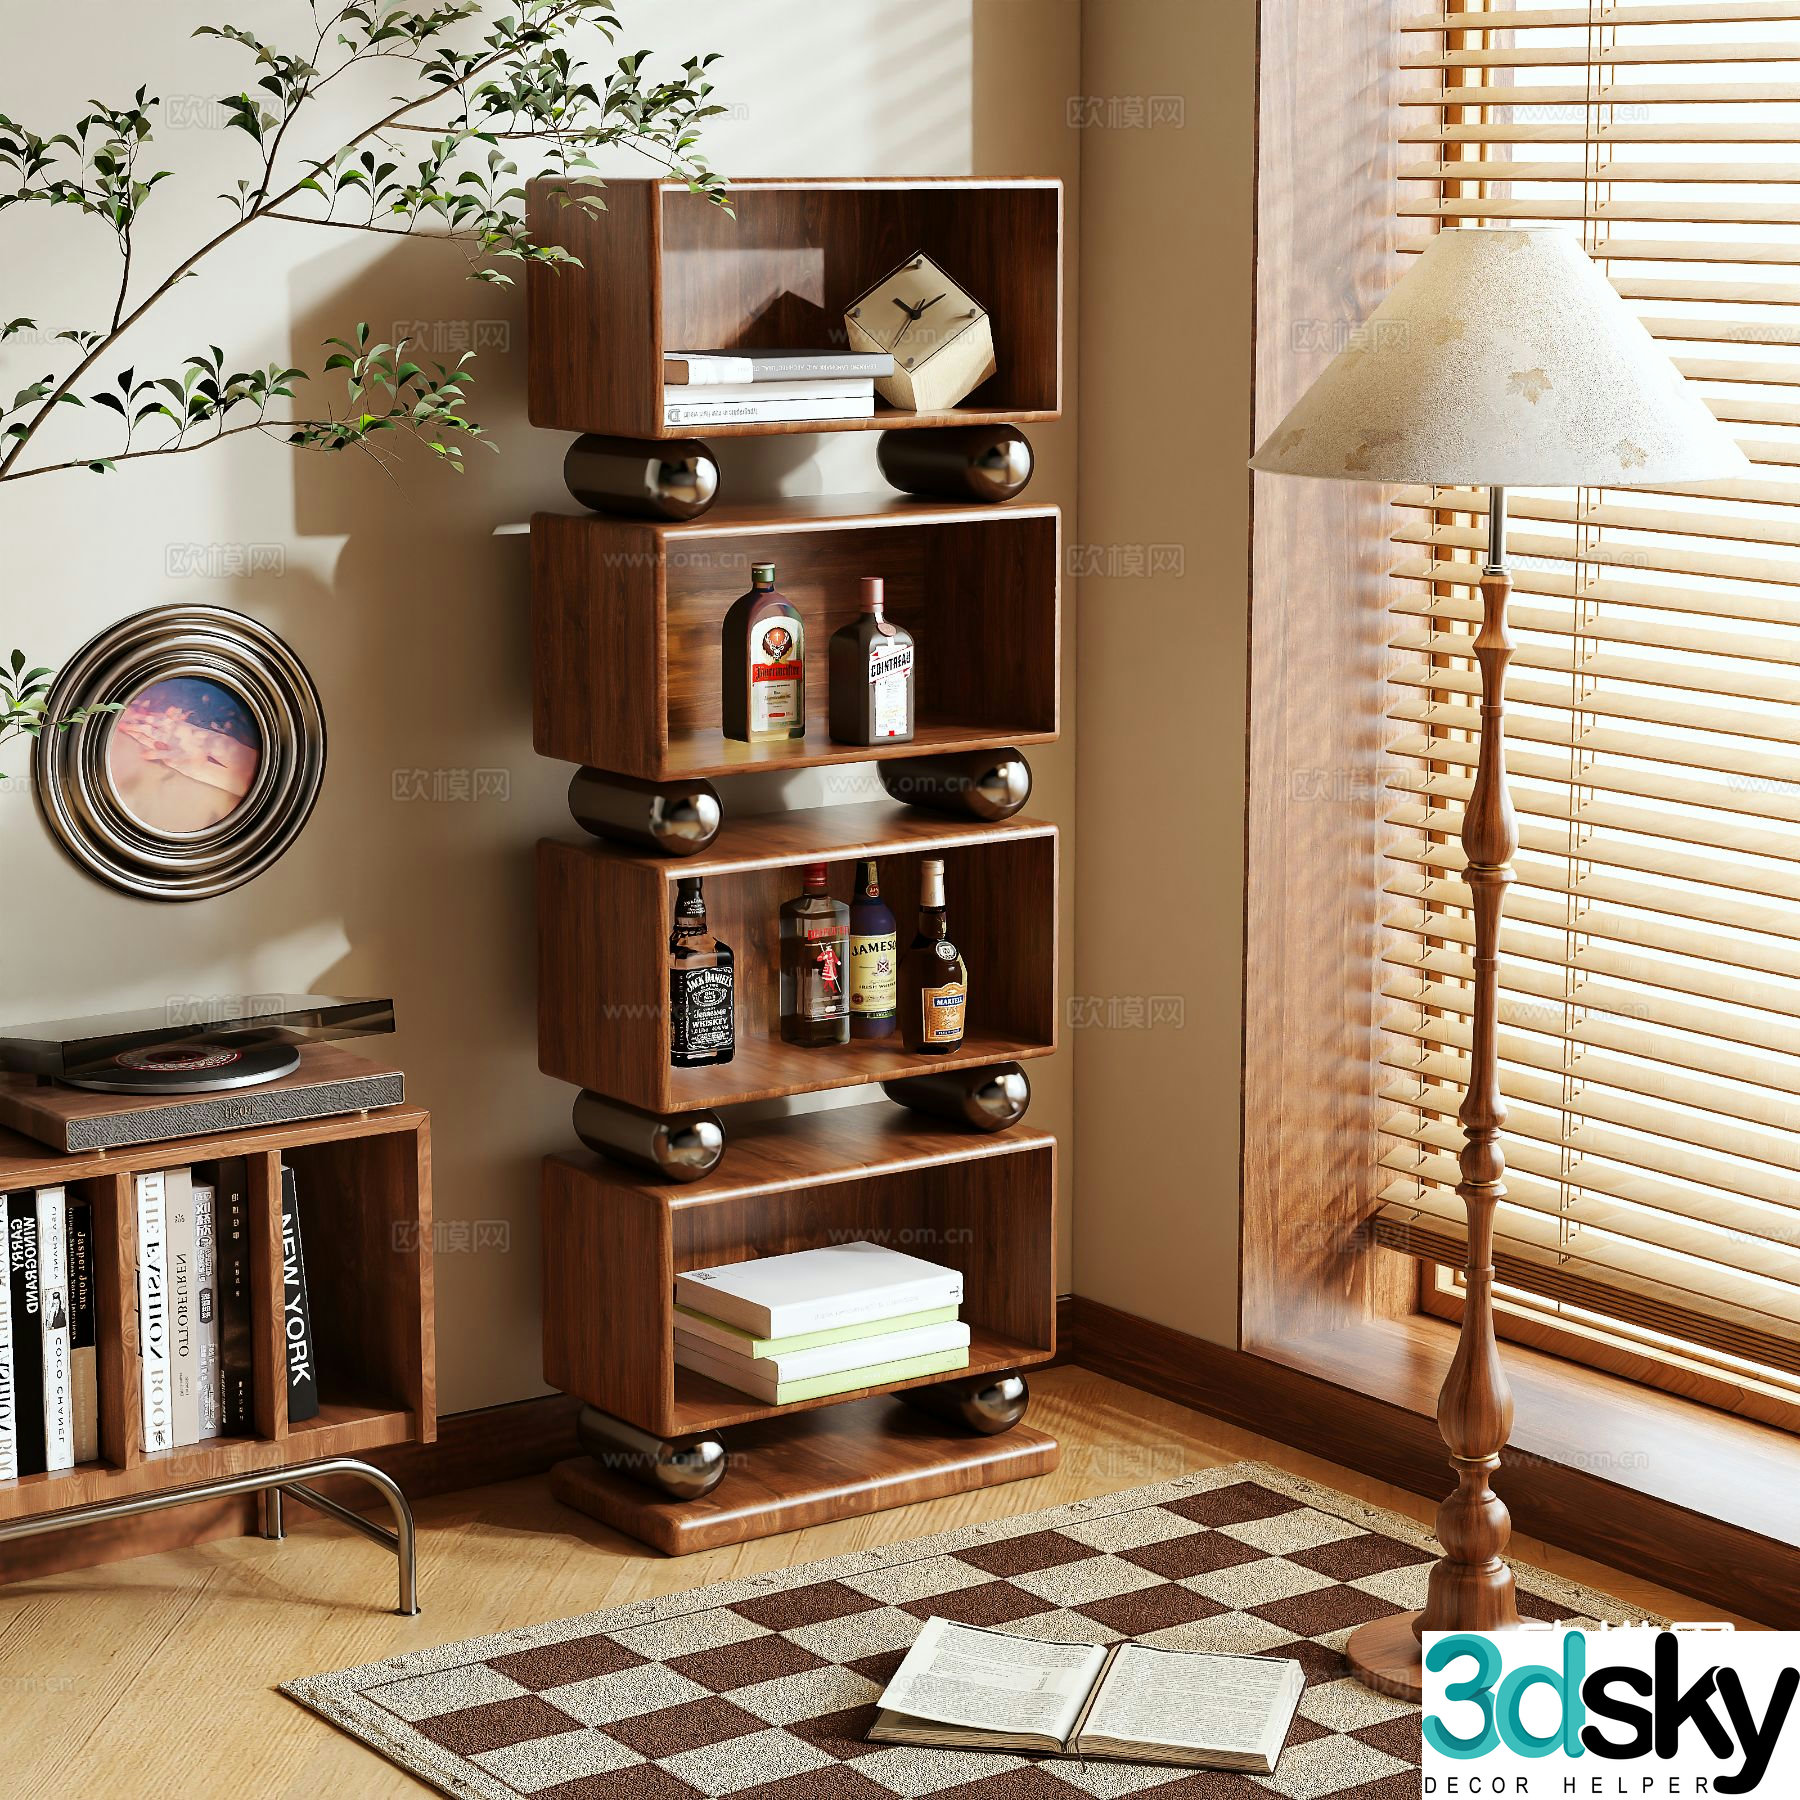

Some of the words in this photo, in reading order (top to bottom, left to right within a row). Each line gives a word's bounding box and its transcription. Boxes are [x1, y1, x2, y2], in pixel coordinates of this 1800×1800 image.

[870, 651, 911, 677] COINTREAU
[686, 975, 705, 992] JACK
[692, 1018, 728, 1029] WHISKEY
[76, 1231, 87, 1271] Jasper
[281, 1213, 300, 1286] NEW
[79, 1274, 88, 1310] Johns
[284, 1294, 312, 1387] YORK
